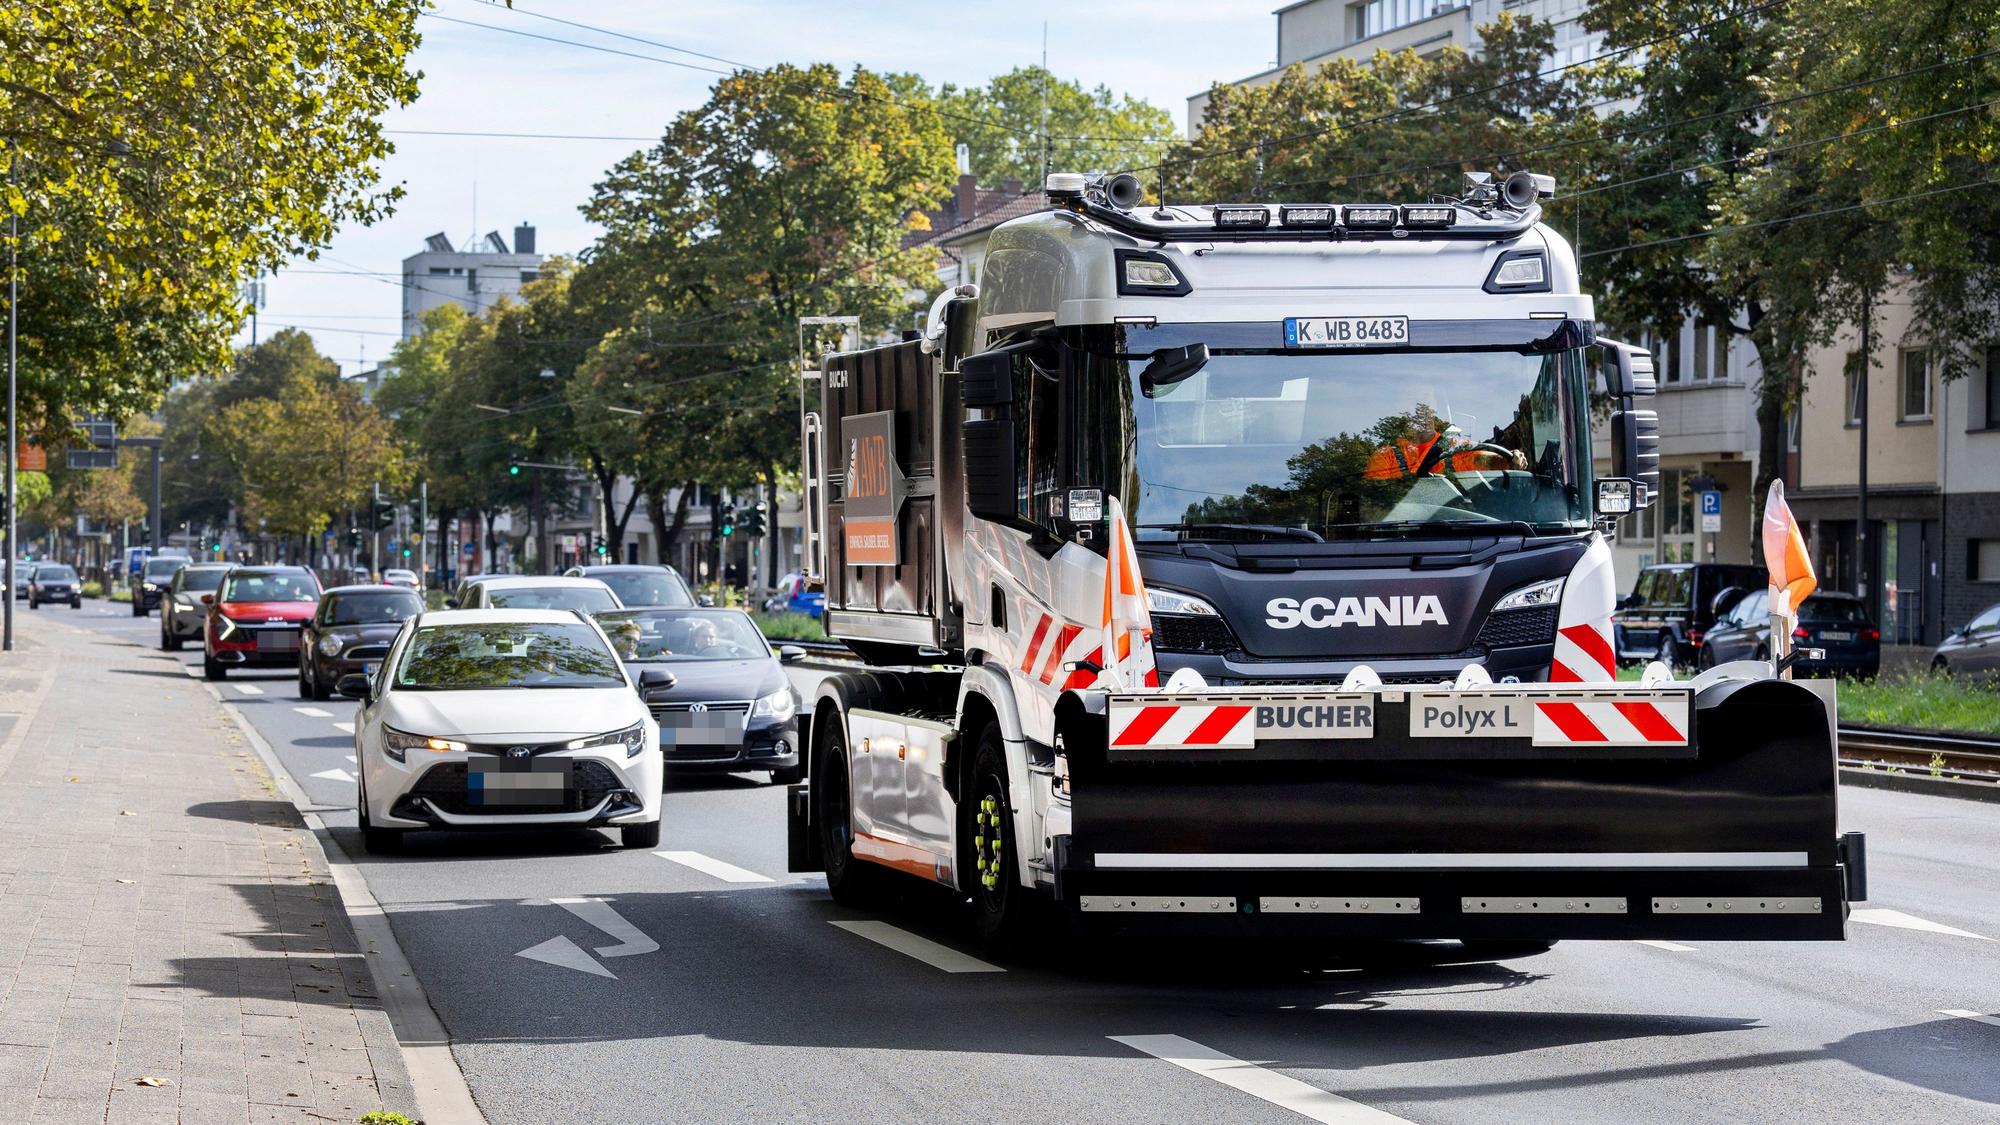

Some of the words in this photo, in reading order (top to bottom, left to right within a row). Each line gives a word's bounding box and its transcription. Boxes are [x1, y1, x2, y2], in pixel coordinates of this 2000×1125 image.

[1298, 321, 1312, 341] K
[1325, 321, 1352, 341] WB
[1356, 320, 1405, 340] 8483
[861, 434, 887, 497] AWB
[1703, 494, 1716, 513] P
[1265, 595, 1449, 630] SCANIA
[1256, 705, 1373, 728] BUCHER
[1424, 704, 1496, 735] Polyx
[1504, 705, 1518, 727] L
